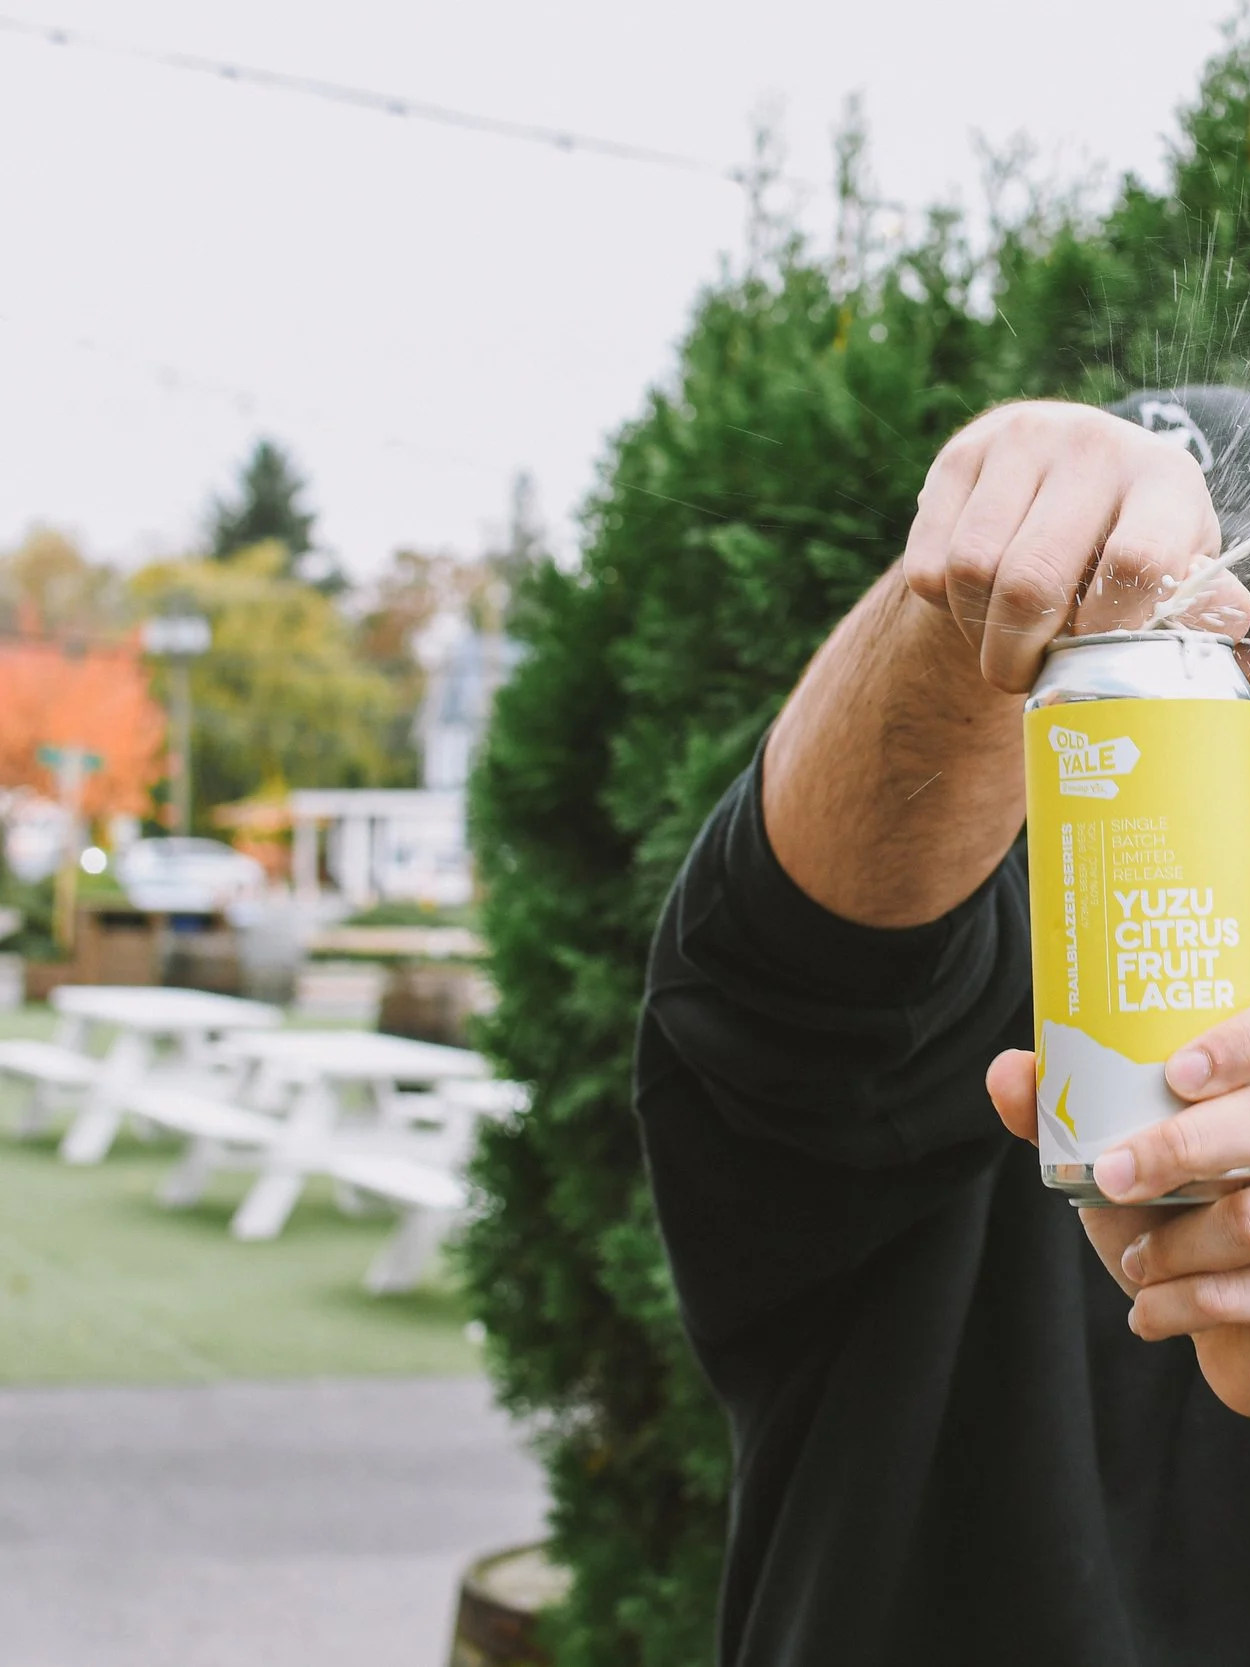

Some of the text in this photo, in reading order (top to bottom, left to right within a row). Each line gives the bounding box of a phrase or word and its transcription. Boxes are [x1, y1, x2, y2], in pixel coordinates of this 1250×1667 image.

[1056, 731, 1085, 749] OLD
[1062, 745, 1117, 775] YALE
[1111, 816, 1168, 833] SINGLE
[1112, 834, 1166, 849] BATCH
[1113, 849, 1175, 866] LIMITED
[1113, 865, 1184, 881] RELEASE
[1114, 888, 1213, 918] YUZU
[1061, 823, 1079, 1016] TRAILBLAZER SERIES
[1115, 918, 1240, 949] CITRUS
[1117, 950, 1220, 981] FRUIT
[1118, 980, 1235, 1012] LAGER
